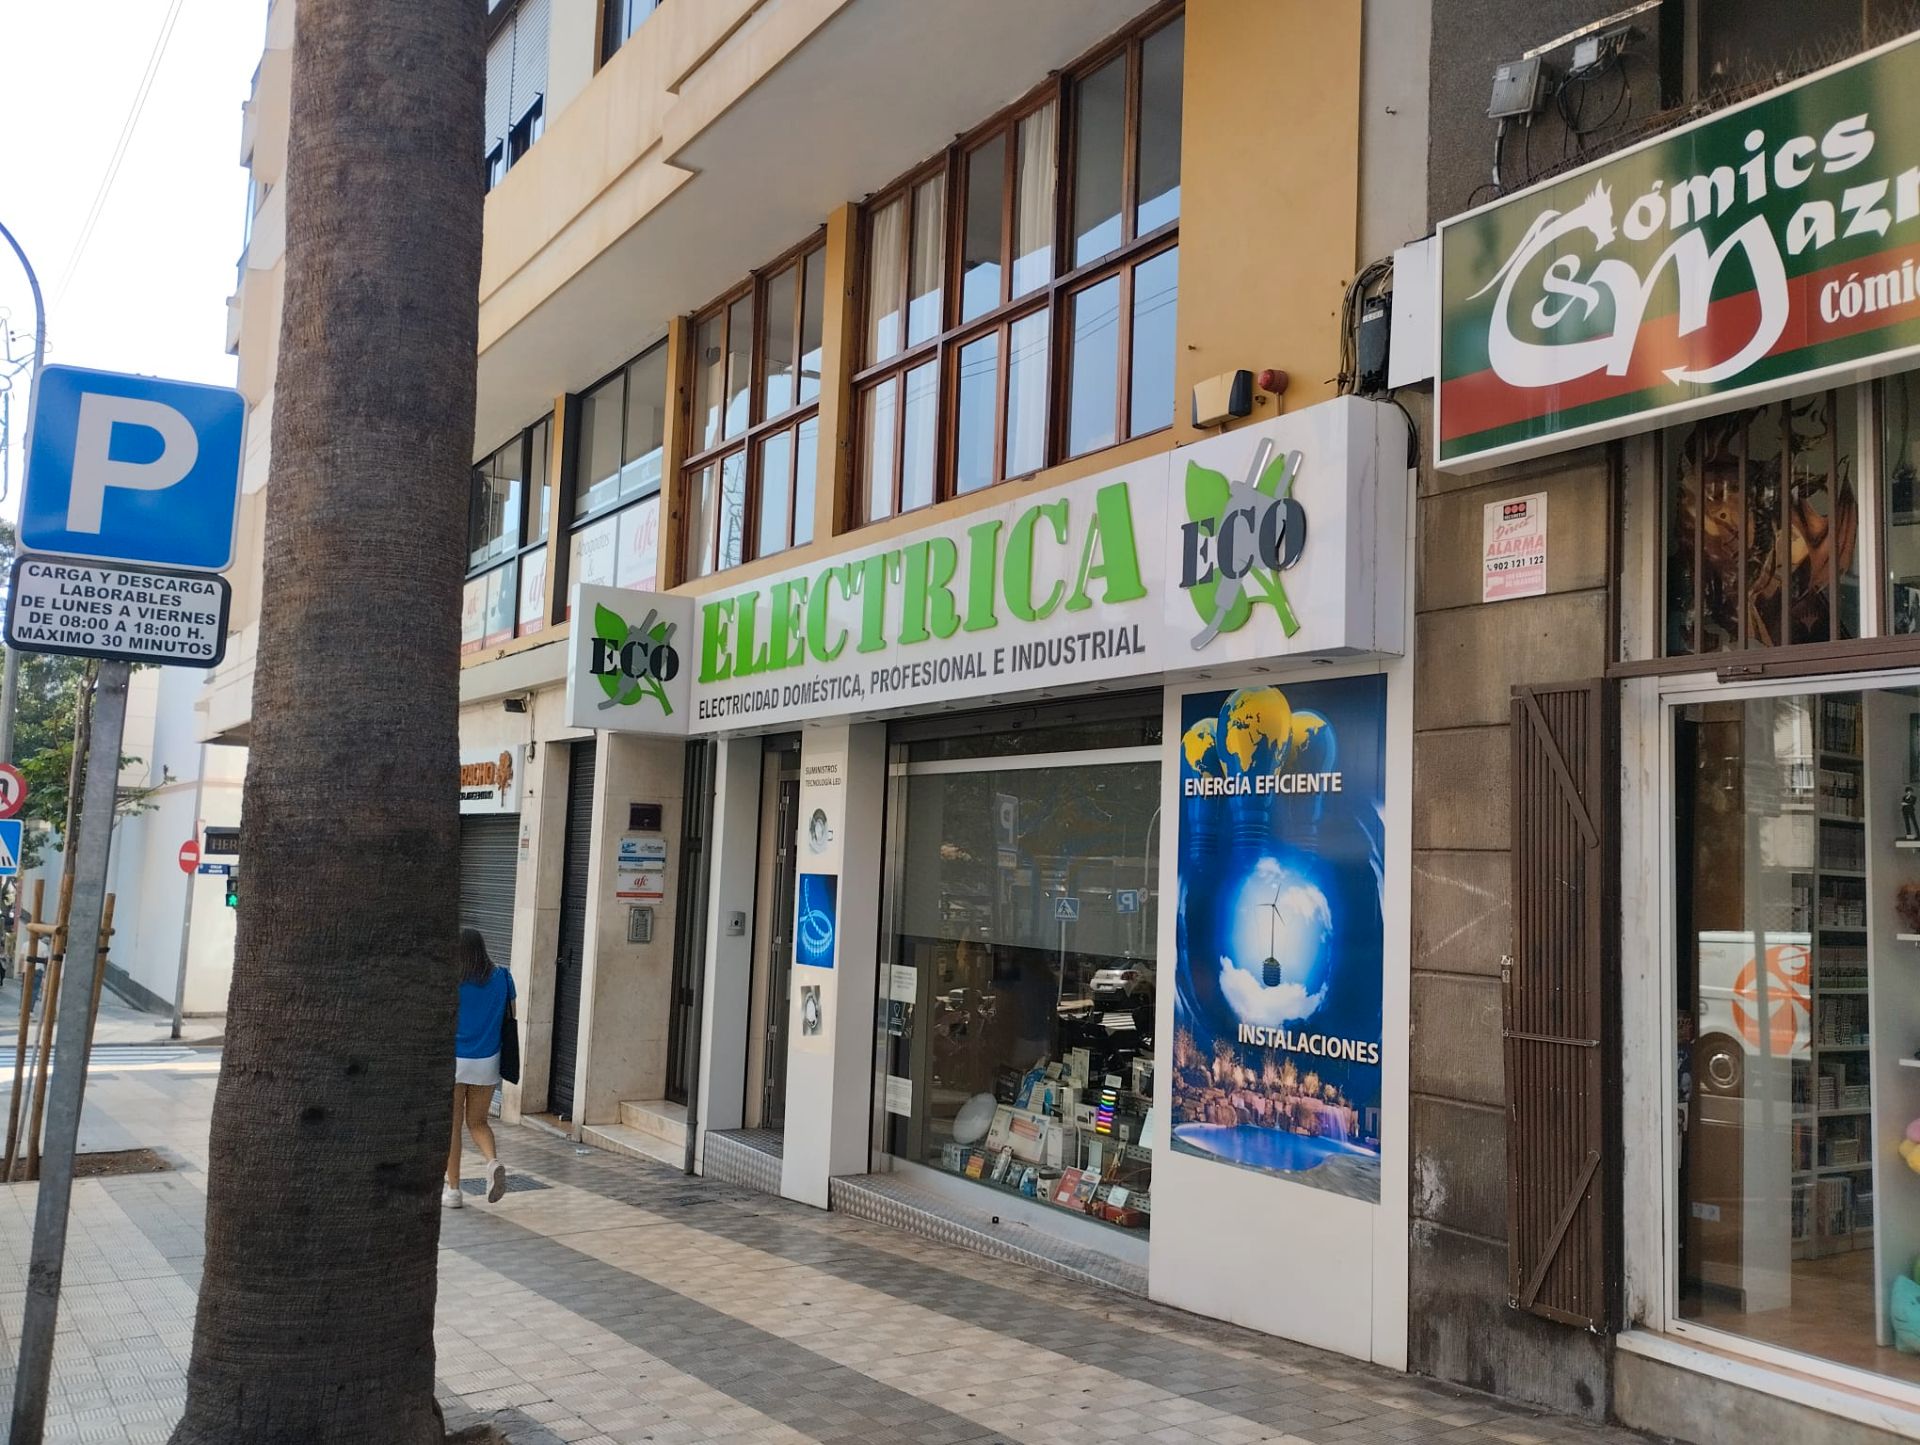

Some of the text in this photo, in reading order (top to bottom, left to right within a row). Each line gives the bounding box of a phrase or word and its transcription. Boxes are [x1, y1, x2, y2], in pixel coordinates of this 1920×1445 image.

[1820, 258, 1920, 323] Cómi
[66, 391, 199, 535] P
[1179, 497, 1307, 588] ECO
[1487, 534, 1544, 556] ALARMA
[1493, 555, 1544, 570] 902 121 122
[28, 565, 215, 595] CARGA Y DESCARGA
[60, 583, 182, 607] LABORABLES
[698, 482, 1147, 684] ELECTRICA
[21, 595, 216, 625] DE LUNES A VIERNES
[29, 611, 204, 640] DE 08:00 A 18:00 H.
[18, 625, 213, 656] MÁXIMO 30 MINUTOS
[590, 637, 679, 682] ECO
[699, 624, 1146, 720] ELECTRICIDAD DOMÉSTICA, PROFESIONAL E INDUSTRIAL
[1184, 772, 1342, 796] ENERGÍA EFICIENTE
[1238, 1023, 1379, 1064] INSTALACIONES
